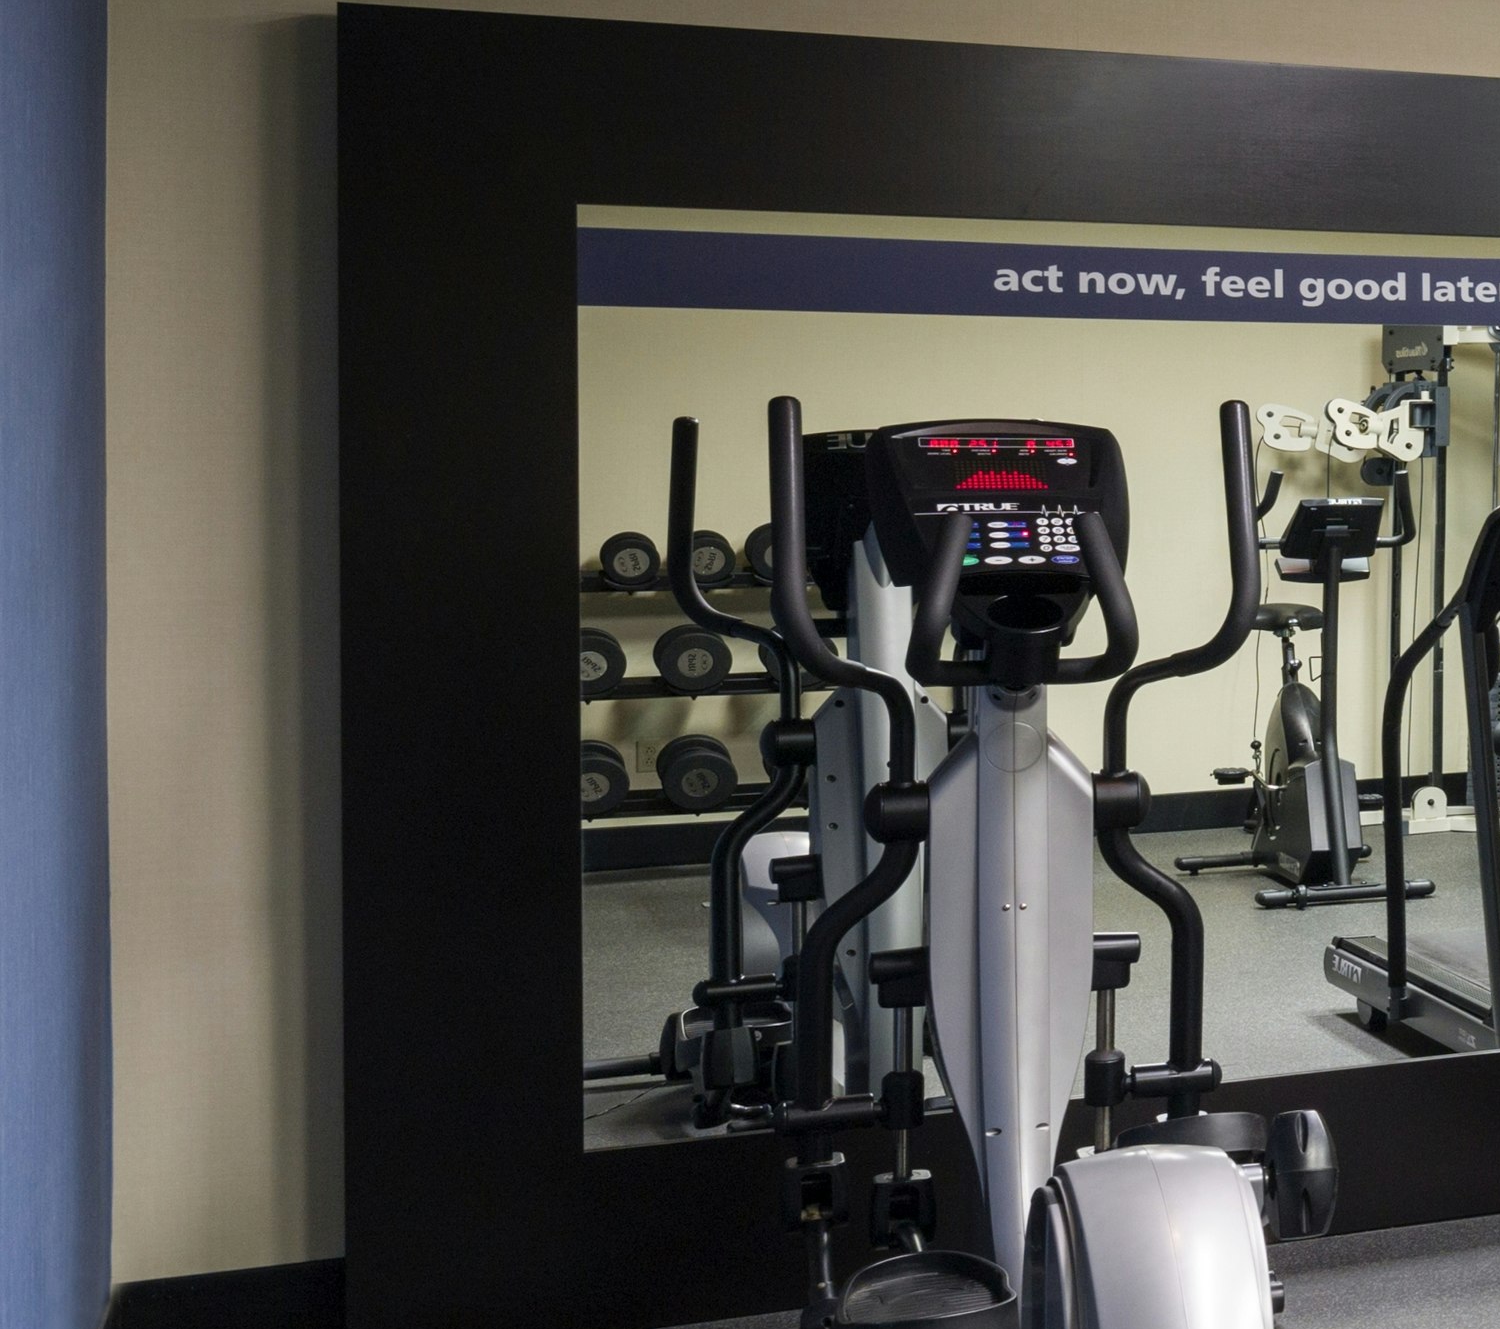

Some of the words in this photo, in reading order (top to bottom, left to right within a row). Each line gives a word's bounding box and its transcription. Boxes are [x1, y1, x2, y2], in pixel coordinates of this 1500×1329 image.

[993, 265, 1063, 293] act
[1079, 271, 1185, 300] now,
[1201, 266, 1284, 298] feel
[1299, 272, 1406, 307] good
[959, 503, 1020, 511] TRUE
